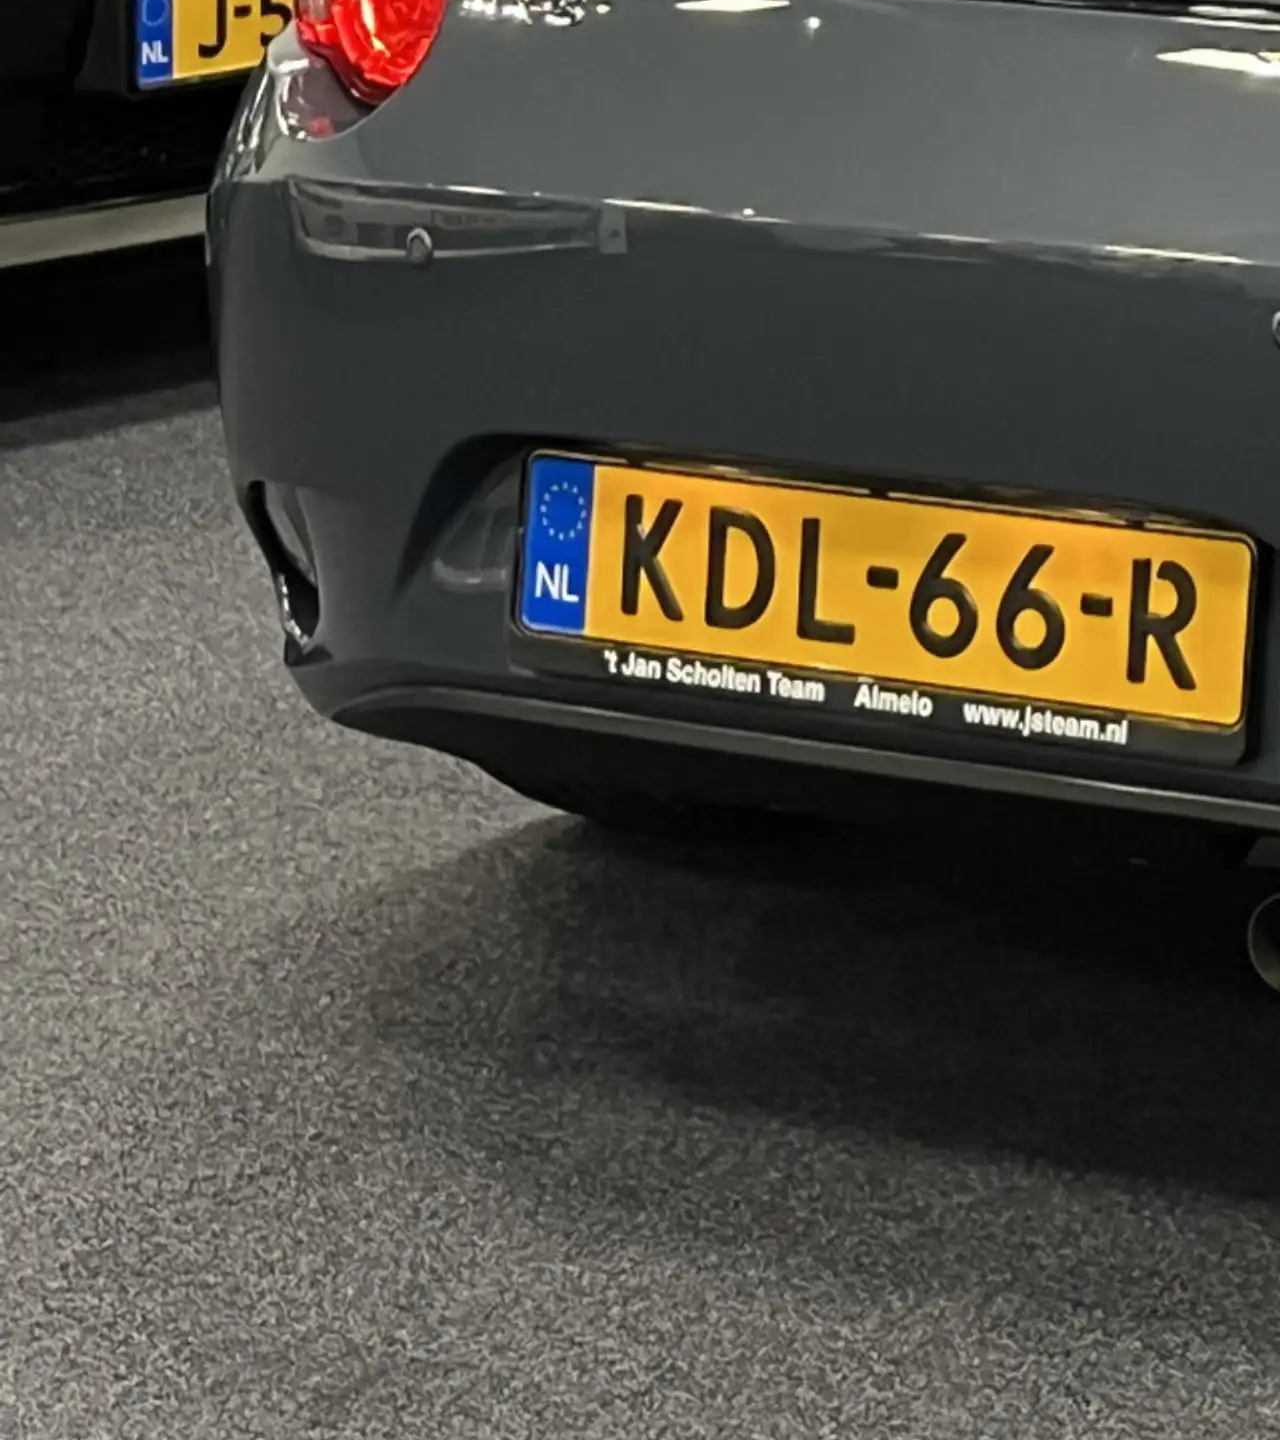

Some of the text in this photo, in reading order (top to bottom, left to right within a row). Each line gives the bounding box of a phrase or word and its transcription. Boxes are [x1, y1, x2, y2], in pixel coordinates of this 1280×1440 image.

[141, 39, 169, 65] NL
[534, 561, 580, 603] NL
[619, 493, 1198, 692] KDL-66-R
[620, 651, 663, 680] Jan
[665, 656, 762, 694] Scholten
[766, 669, 826, 703] Team
[853, 681, 934, 718] Almelo
[962, 701, 1129, 746] www.jsteam.nl
